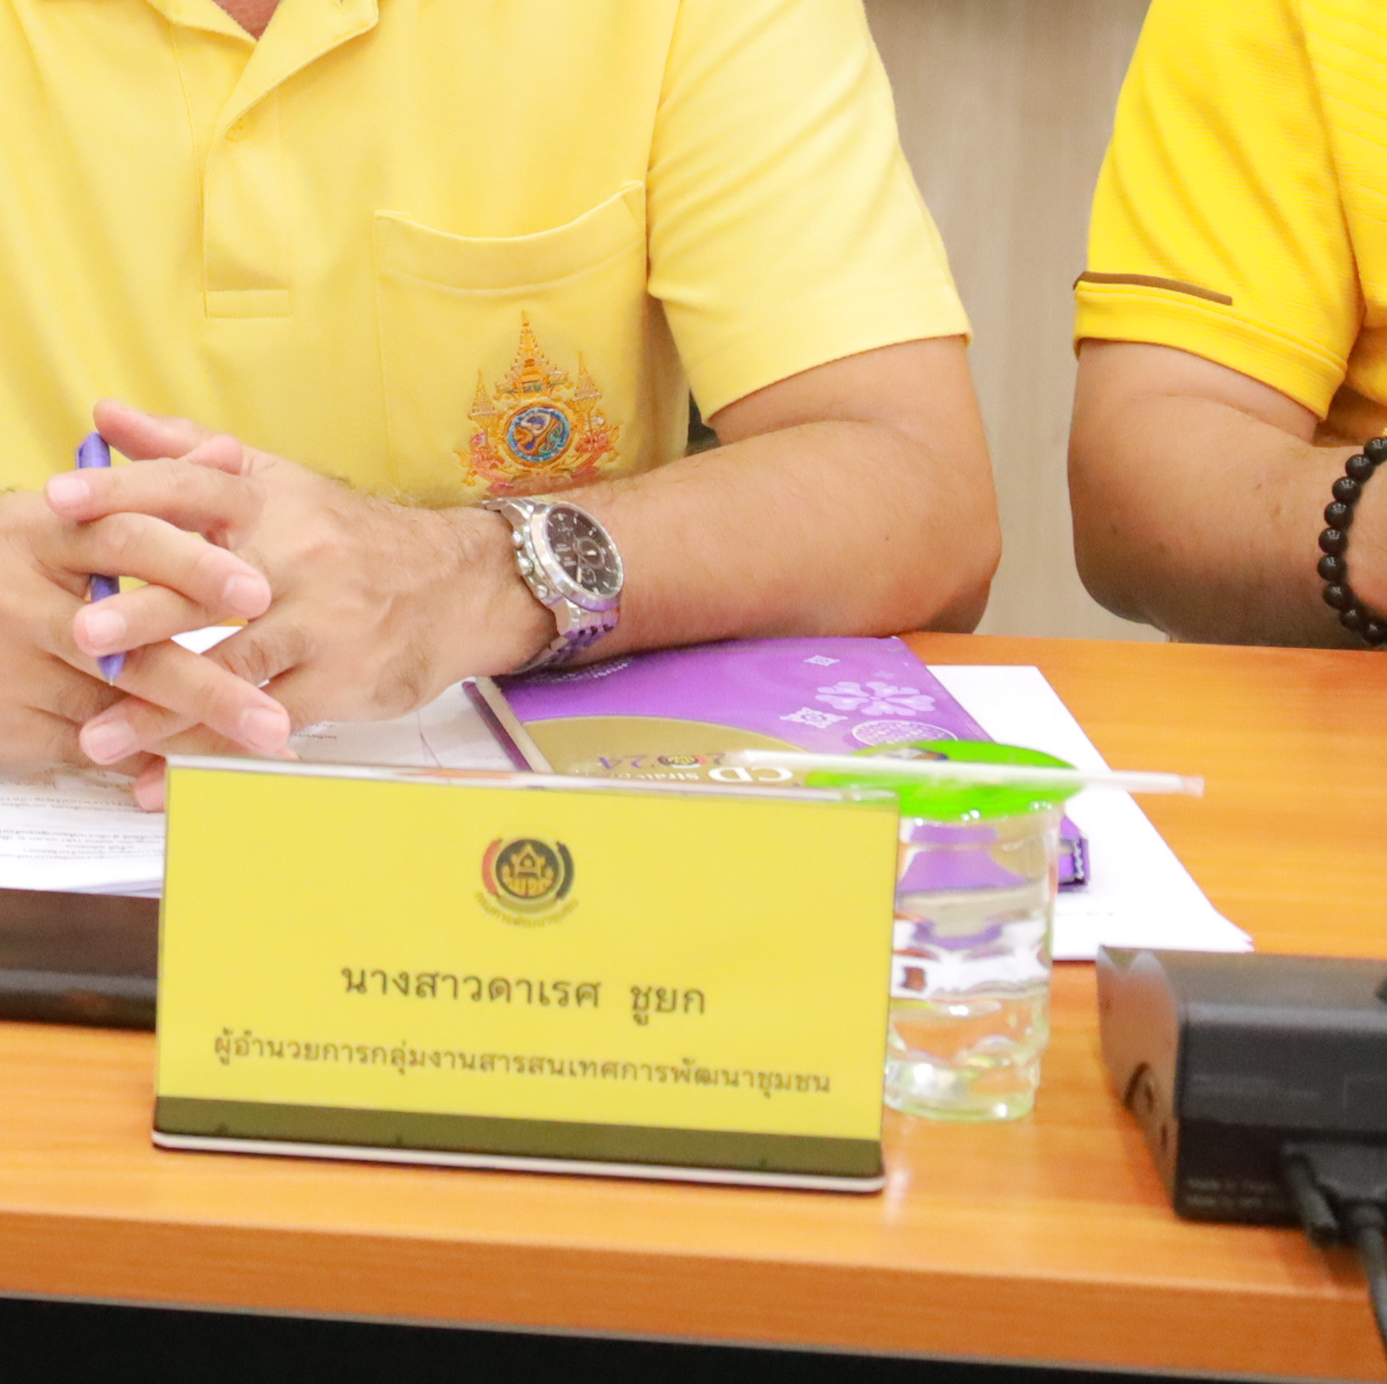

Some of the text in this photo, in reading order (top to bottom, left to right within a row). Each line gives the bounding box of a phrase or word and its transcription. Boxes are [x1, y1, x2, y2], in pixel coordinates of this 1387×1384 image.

[213, 1027, 831, 1099] ผู้อำนวยการกลุ่มงานสารสนเทศการพัฒนาชุมชน
